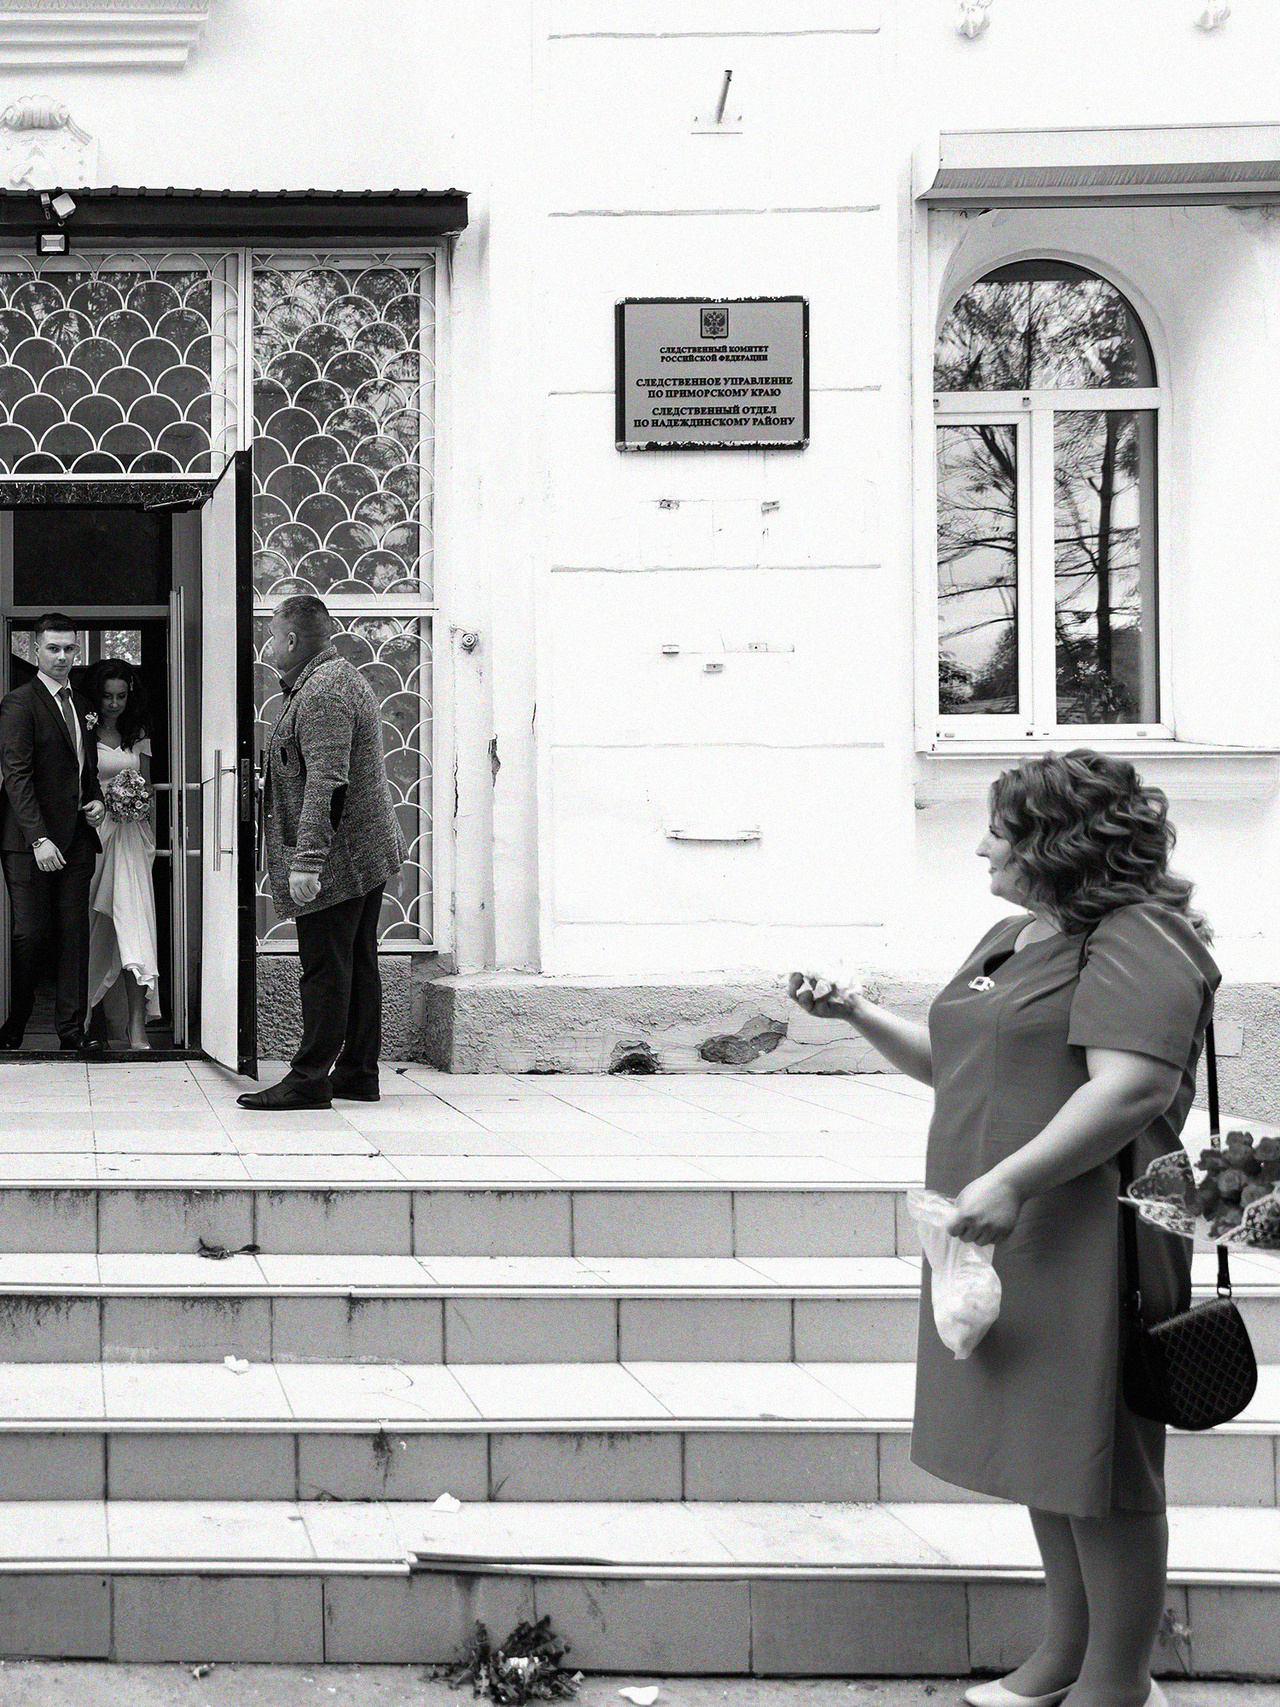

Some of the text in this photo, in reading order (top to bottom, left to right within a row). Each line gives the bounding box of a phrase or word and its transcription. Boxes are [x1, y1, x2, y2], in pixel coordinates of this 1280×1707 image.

[660, 345, 728, 354] СЛЕДСТВЕННЫЙ
[660, 354, 717, 363] РОССИЙСКОЙ
[636, 377, 793, 387] СЛЕДСТВЕННОЕ УПРАВЛЕНИЕ
[648, 388, 781, 398] ПО ПРИМОРСКОМУ КРАЮ
[652, 405, 776, 416] СЛЕДСТВЕННЫЙ ОТДЕЛ
[634, 415, 795, 427] ПО НАДЕЖДИНСКОМУ РАЙОНУ
